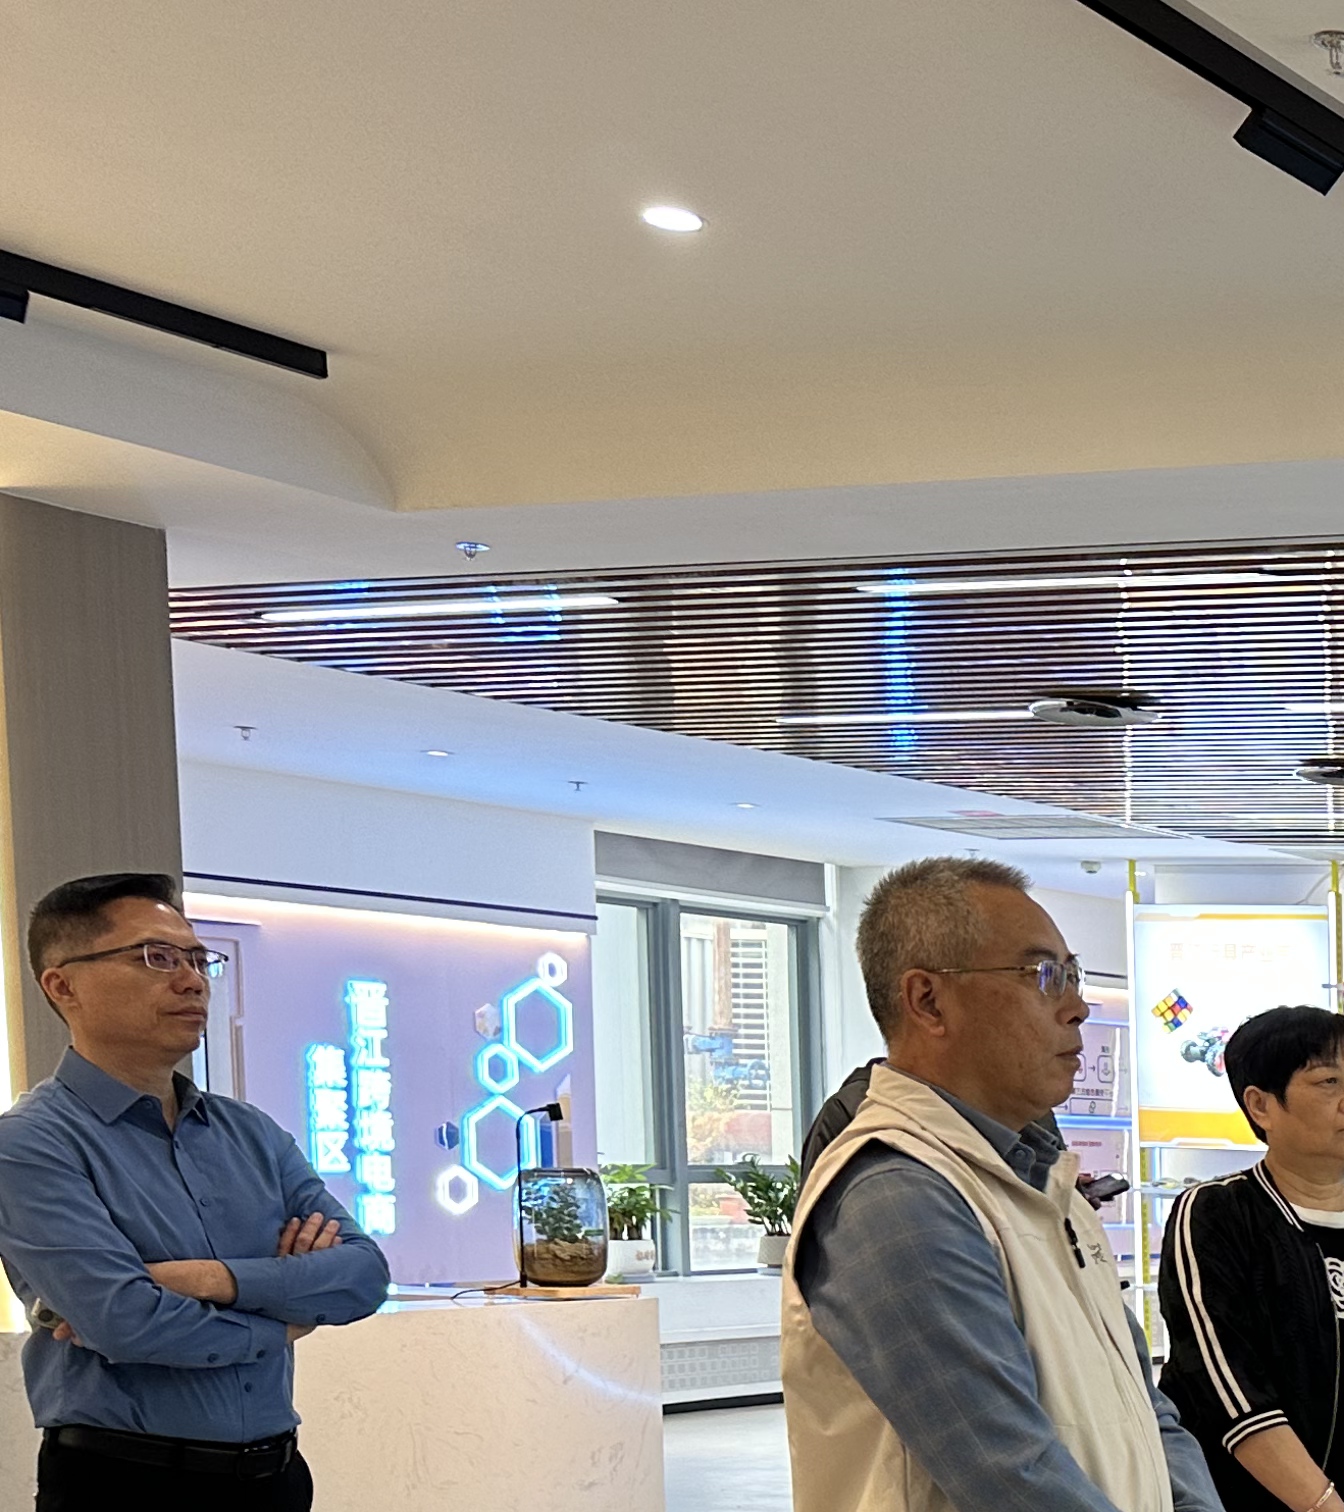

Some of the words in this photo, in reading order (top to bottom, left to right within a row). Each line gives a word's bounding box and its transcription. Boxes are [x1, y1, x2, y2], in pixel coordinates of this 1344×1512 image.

[344, 979, 397, 1236] 晋江跨境电商
